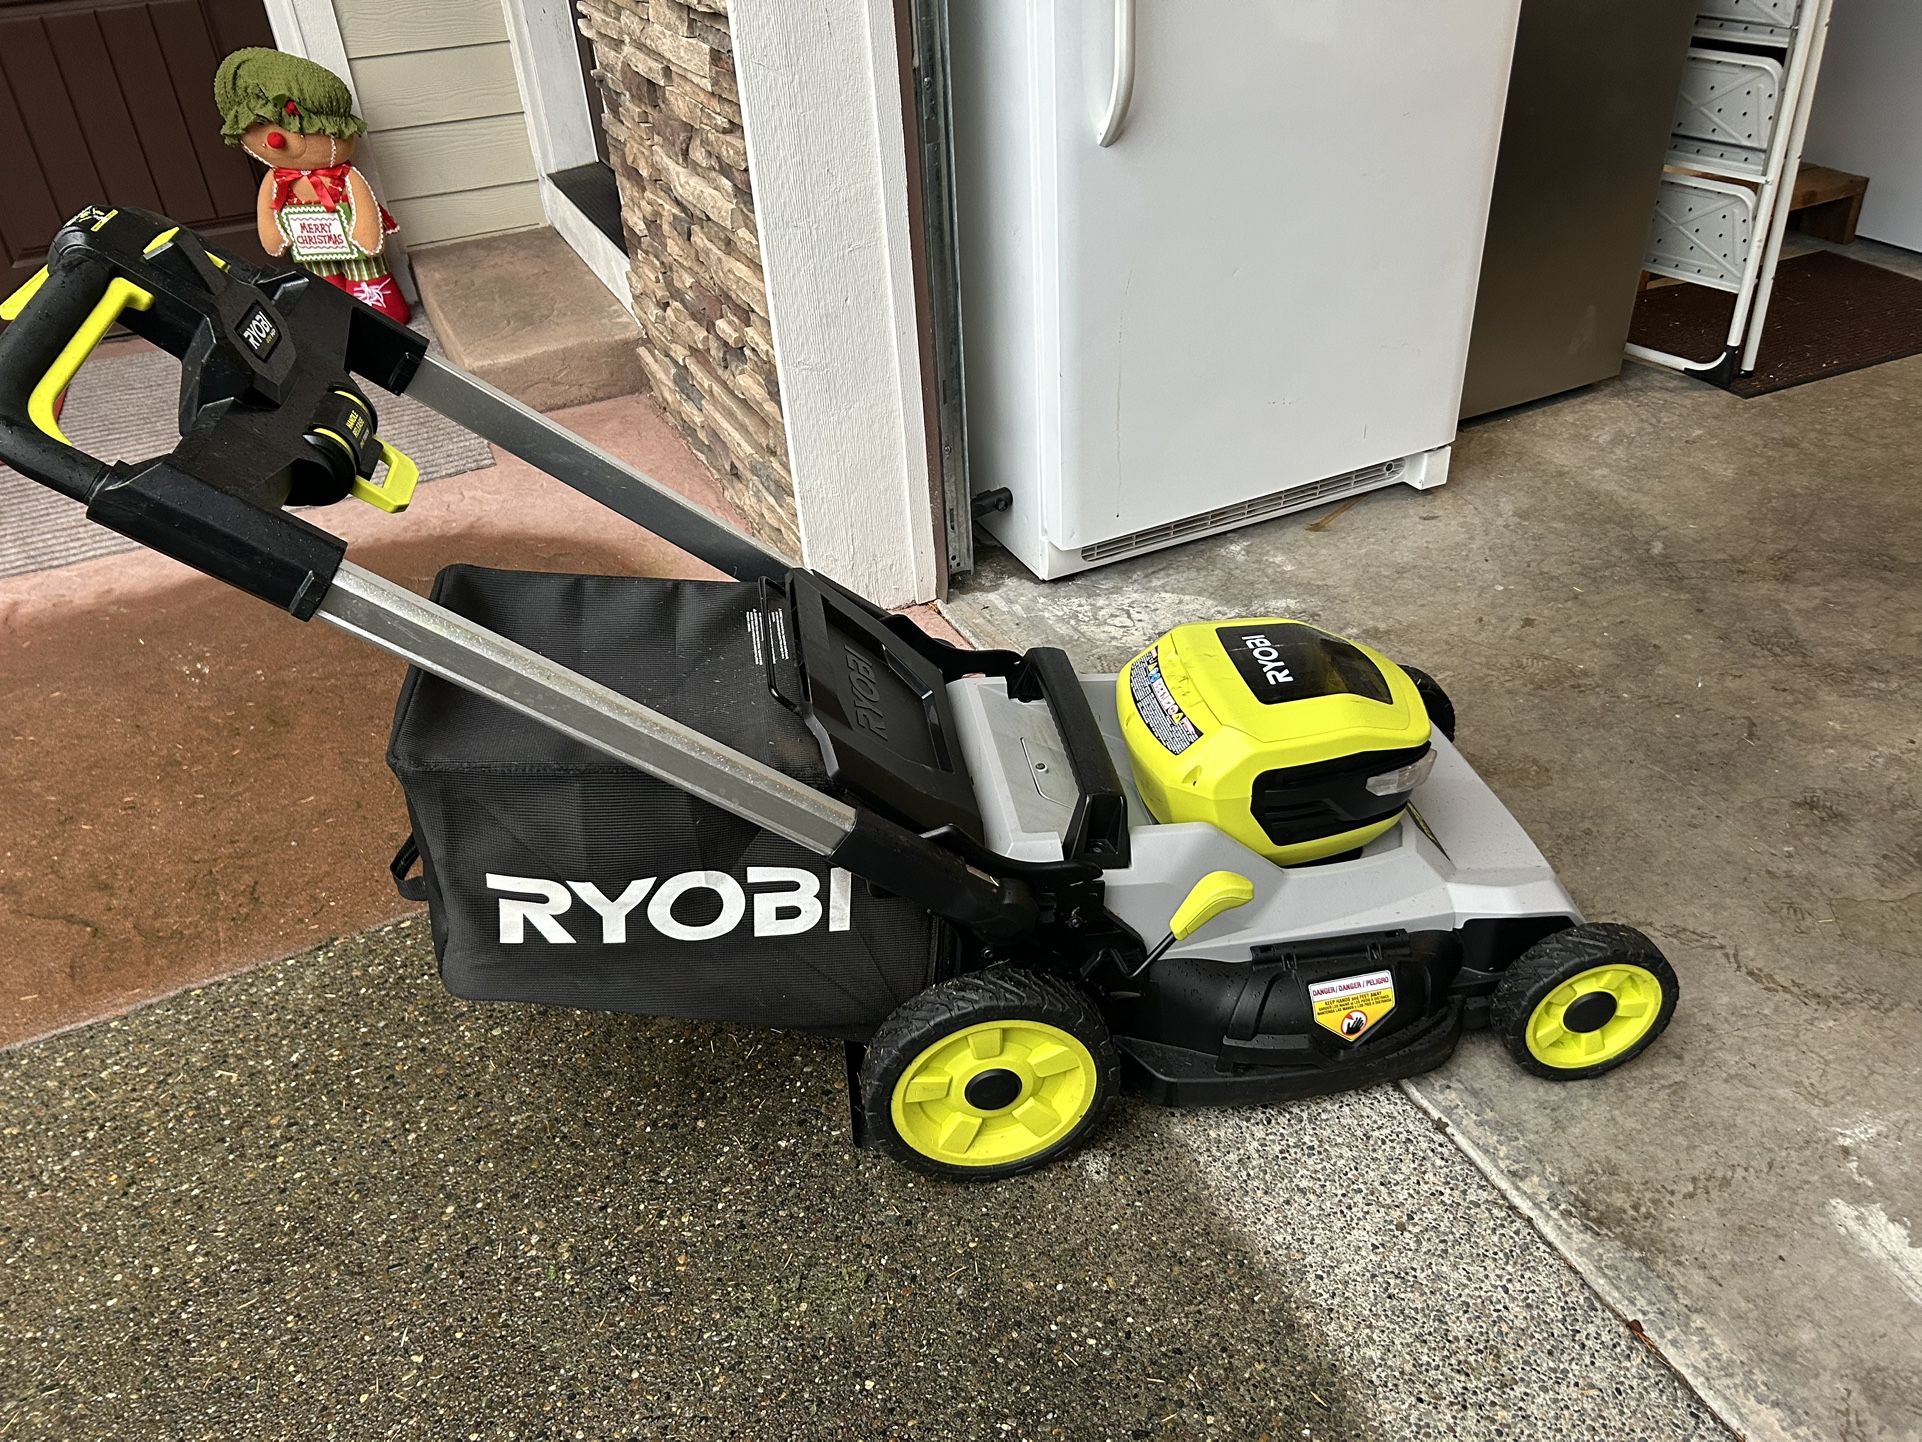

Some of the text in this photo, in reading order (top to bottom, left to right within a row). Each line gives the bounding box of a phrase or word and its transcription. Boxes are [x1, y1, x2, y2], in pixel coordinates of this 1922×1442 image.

[296, 234, 344, 245] CHRISTMAS
[300, 222, 332, 234] MERRY
[243, 311, 272, 349] RYOBI
[1241, 634, 1294, 685] RYOBI
[843, 643, 888, 742] RYOBI
[486, 866, 852, 944] RYOBI
[1339, 982, 1361, 991] DANGER
[1366, 977, 1388, 986] PELIGRO
